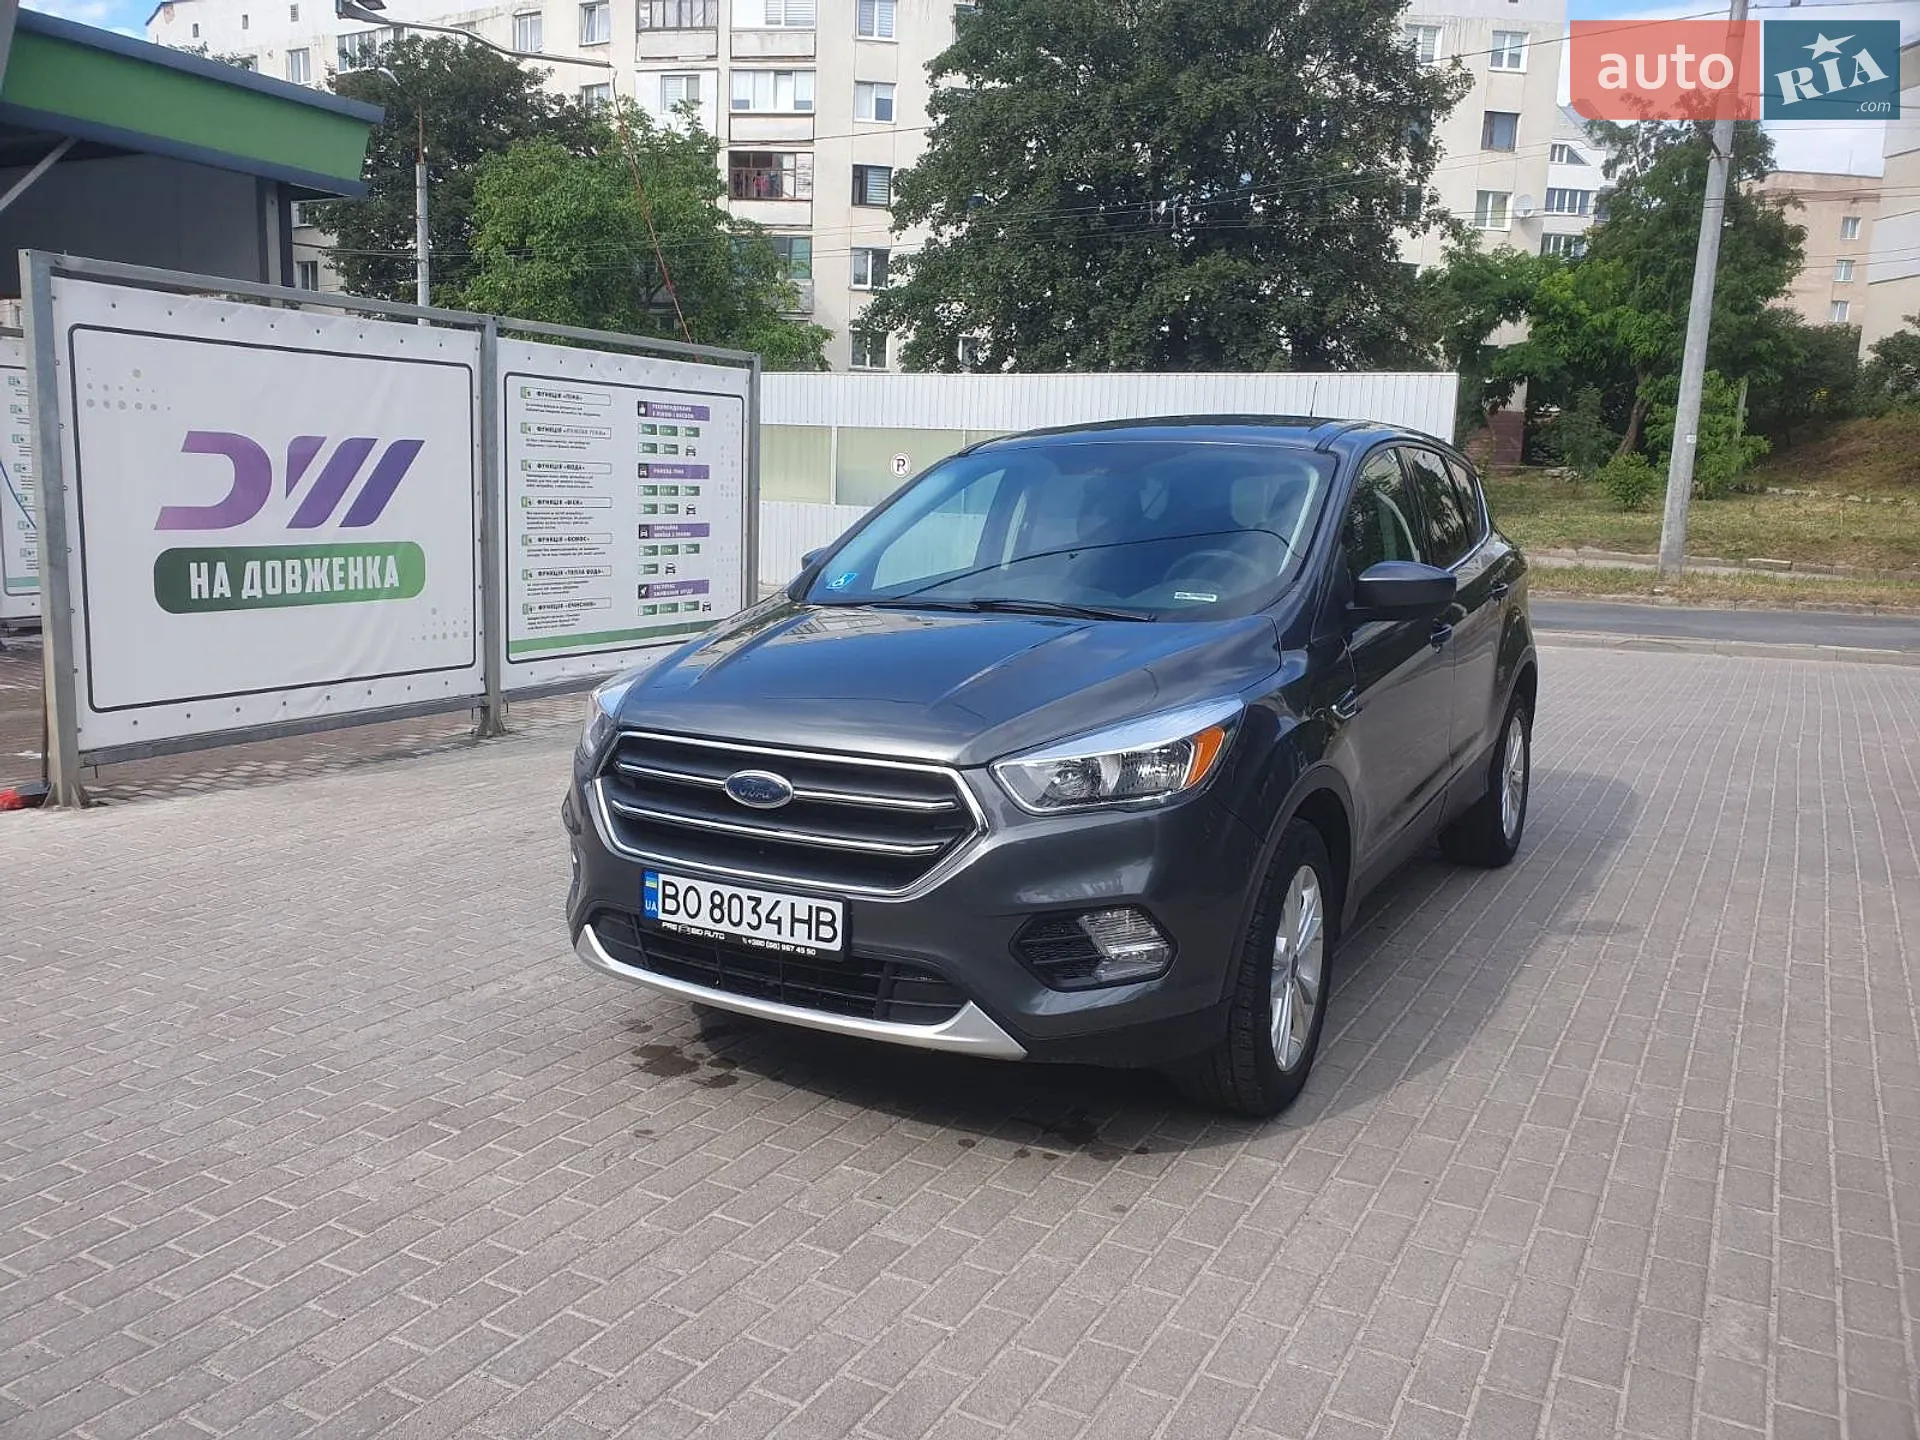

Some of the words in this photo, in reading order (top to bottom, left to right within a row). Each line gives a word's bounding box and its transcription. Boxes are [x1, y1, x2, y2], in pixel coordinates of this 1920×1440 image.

[189, 561, 232, 600] НА
[241, 555, 400, 600] ДОВЖЕНКА
[645, 899, 658, 911] UA
[662, 879, 702, 919] BO
[709, 890, 783, 935] 8034
[789, 902, 838, 944] HB
